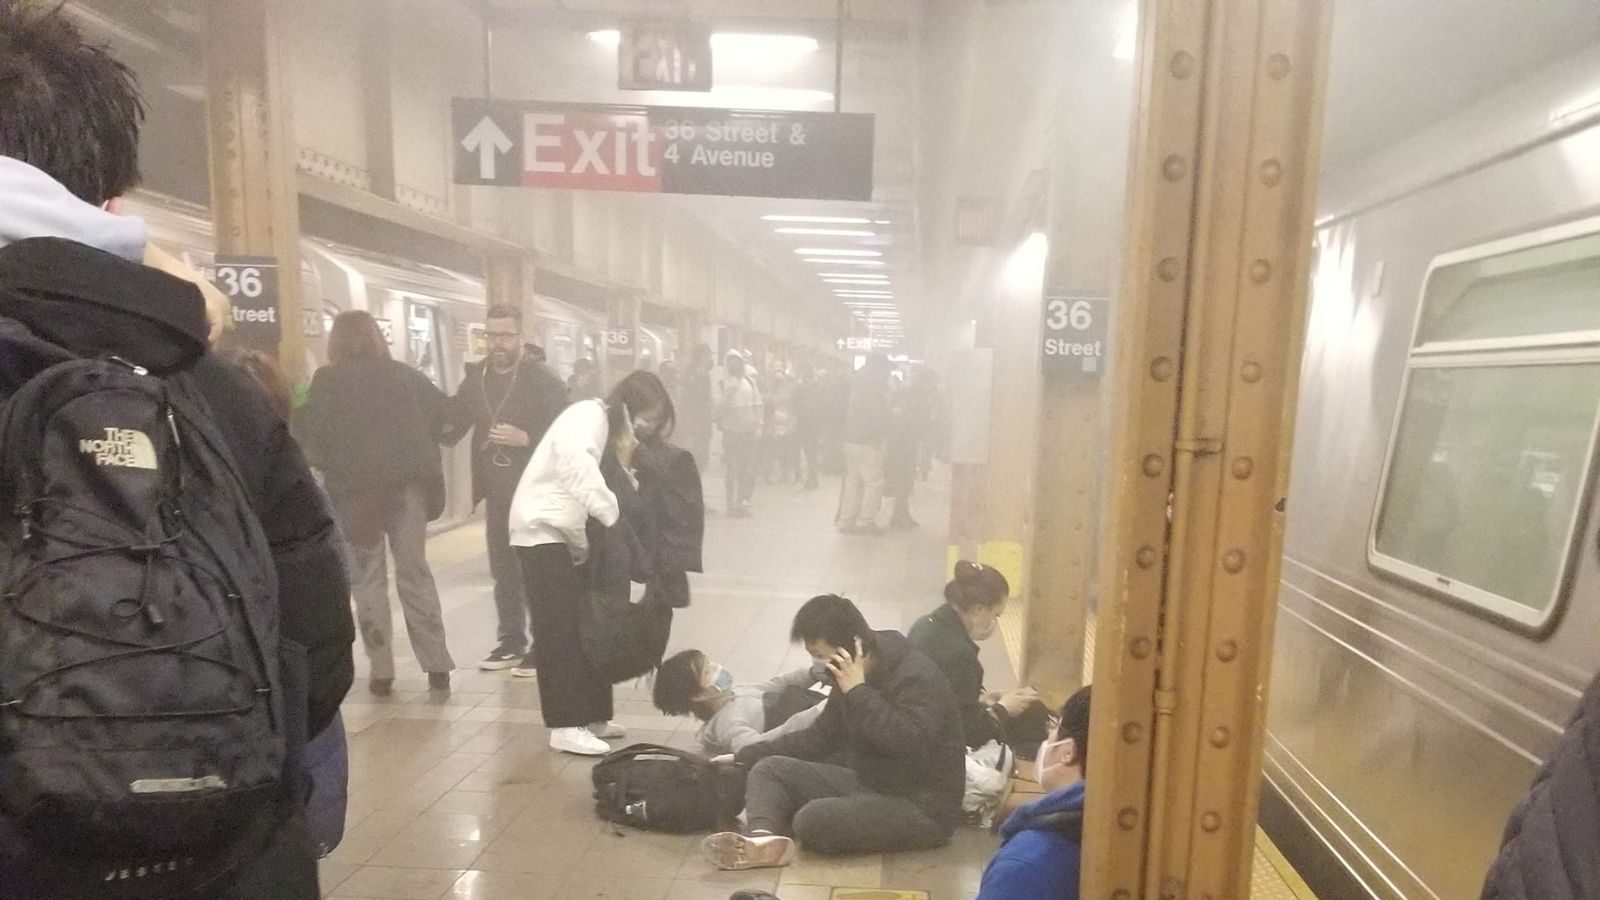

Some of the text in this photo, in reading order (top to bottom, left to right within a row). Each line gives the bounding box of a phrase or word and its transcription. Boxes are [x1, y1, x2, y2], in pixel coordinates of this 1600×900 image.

[664, 119, 806, 145] 36 Street &
[523, 113, 657, 177] Exit
[664, 142, 776, 168] 4 Avenue
[217, 267, 263, 298] 36
[231, 305, 277, 323] treet
[1046, 299, 1092, 331] 36
[607, 330, 629, 345] 36
[1044, 338, 1102, 357] Street
[104, 427, 135, 442] THE
[79, 439, 137, 454] NORTH
[95, 453, 136, 468] FACE
